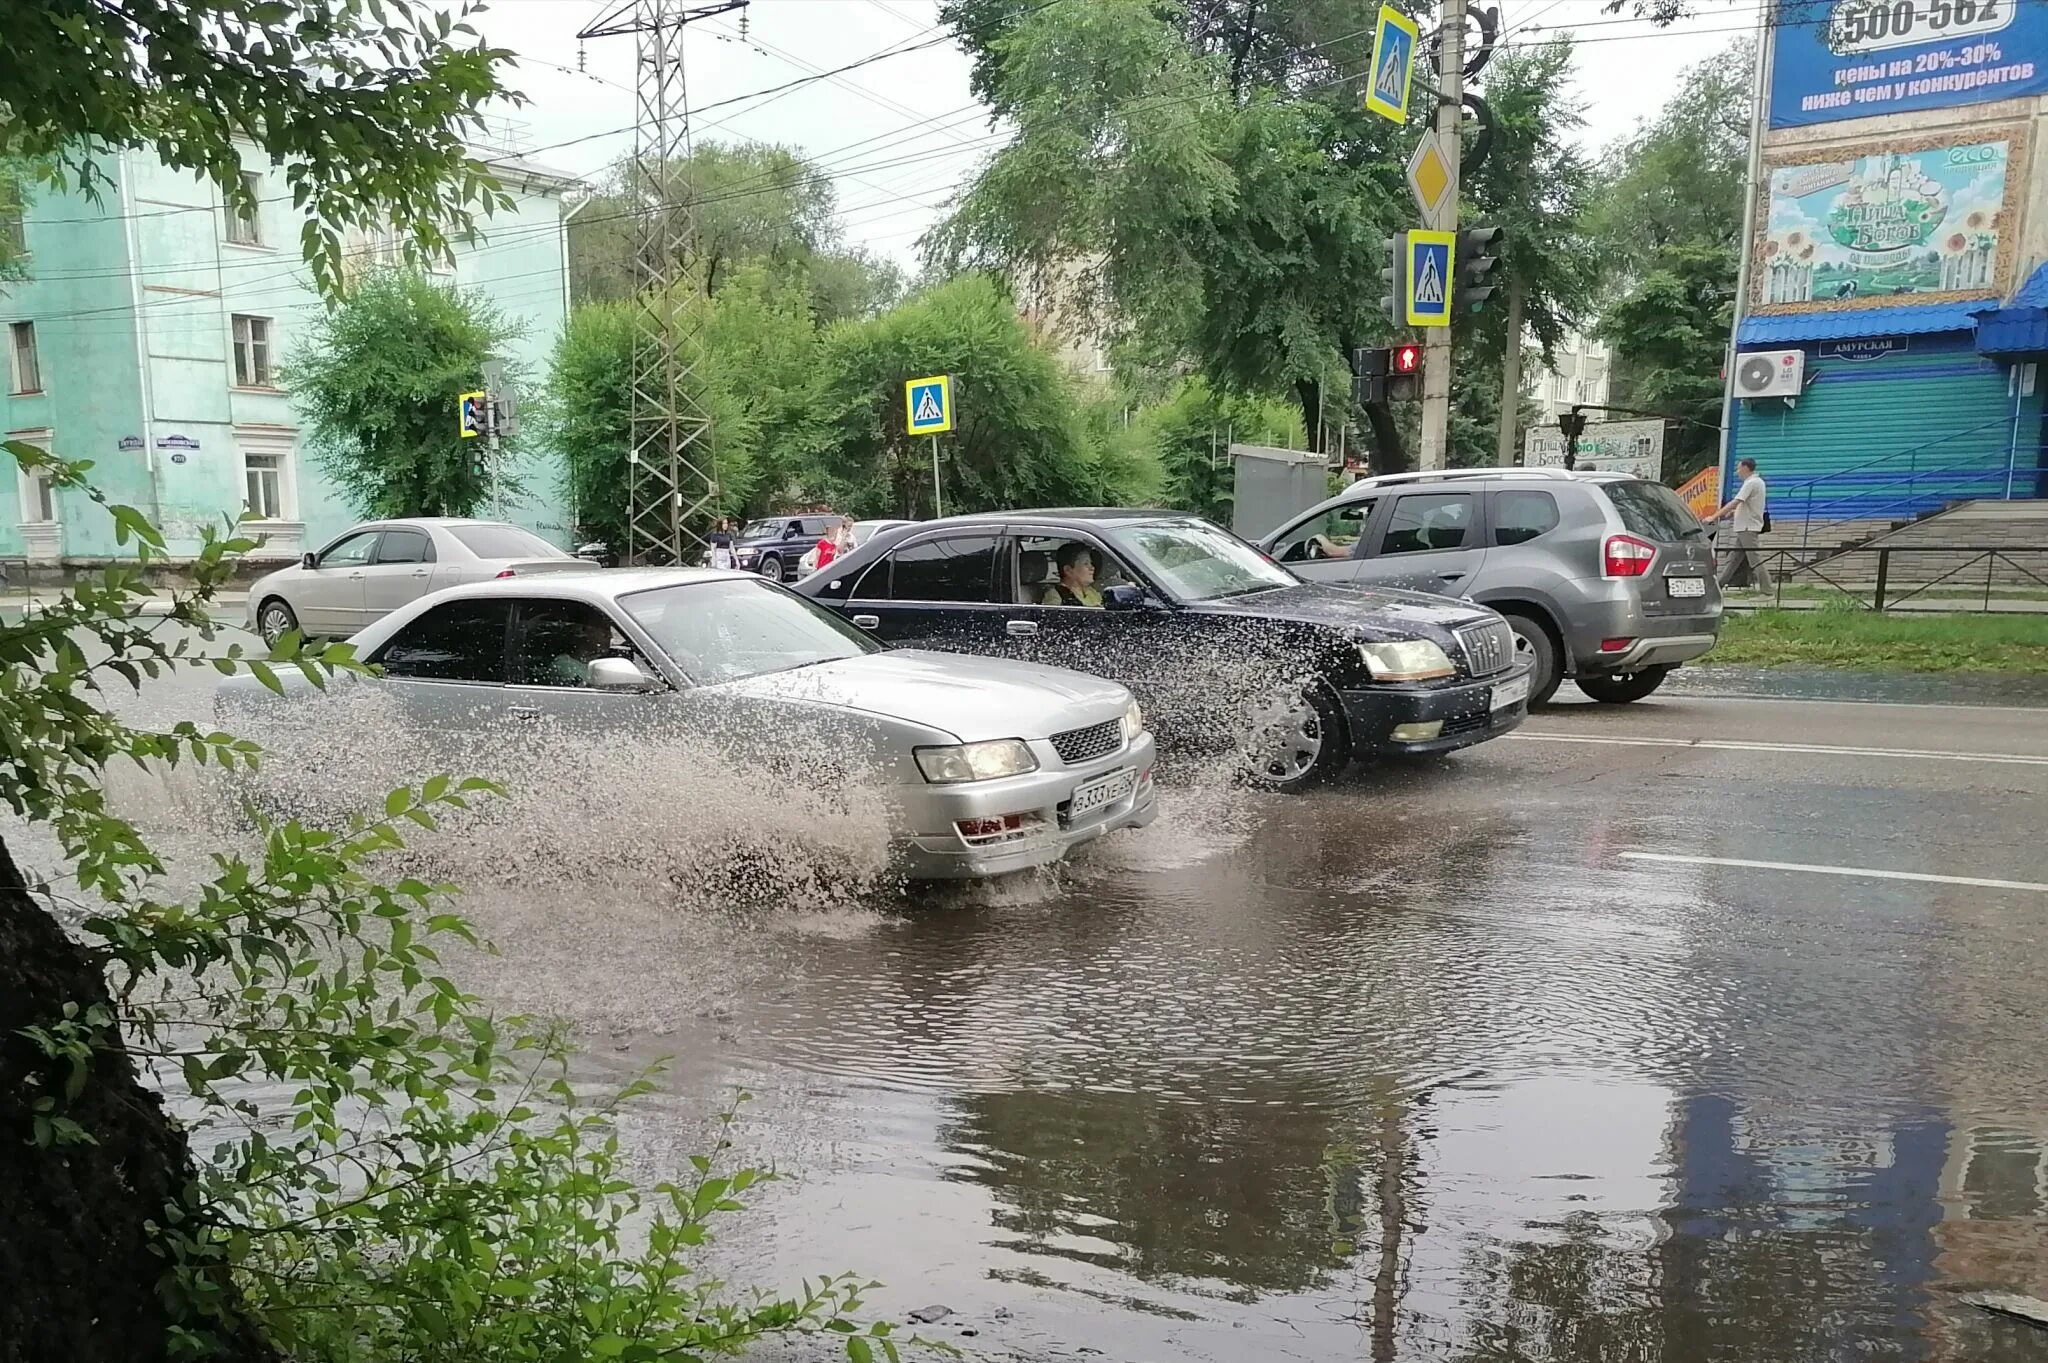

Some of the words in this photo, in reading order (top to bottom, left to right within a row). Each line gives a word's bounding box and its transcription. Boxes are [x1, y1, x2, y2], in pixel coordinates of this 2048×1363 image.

[1844, 0, 1998, 43] 500-562
[1834, 62, 1885, 85] цены
[1889, 59, 1913, 77] на
[1915, 42, 2002, 73] 20%-30%
[1802, 90, 1851, 112] ниже
[1854, 83, 1891, 104] чем
[1893, 82, 1906, 99] у
[1908, 63, 2035, 97] конкурентов
[1833, 340, 1893, 353] АМУРСКАЯ
